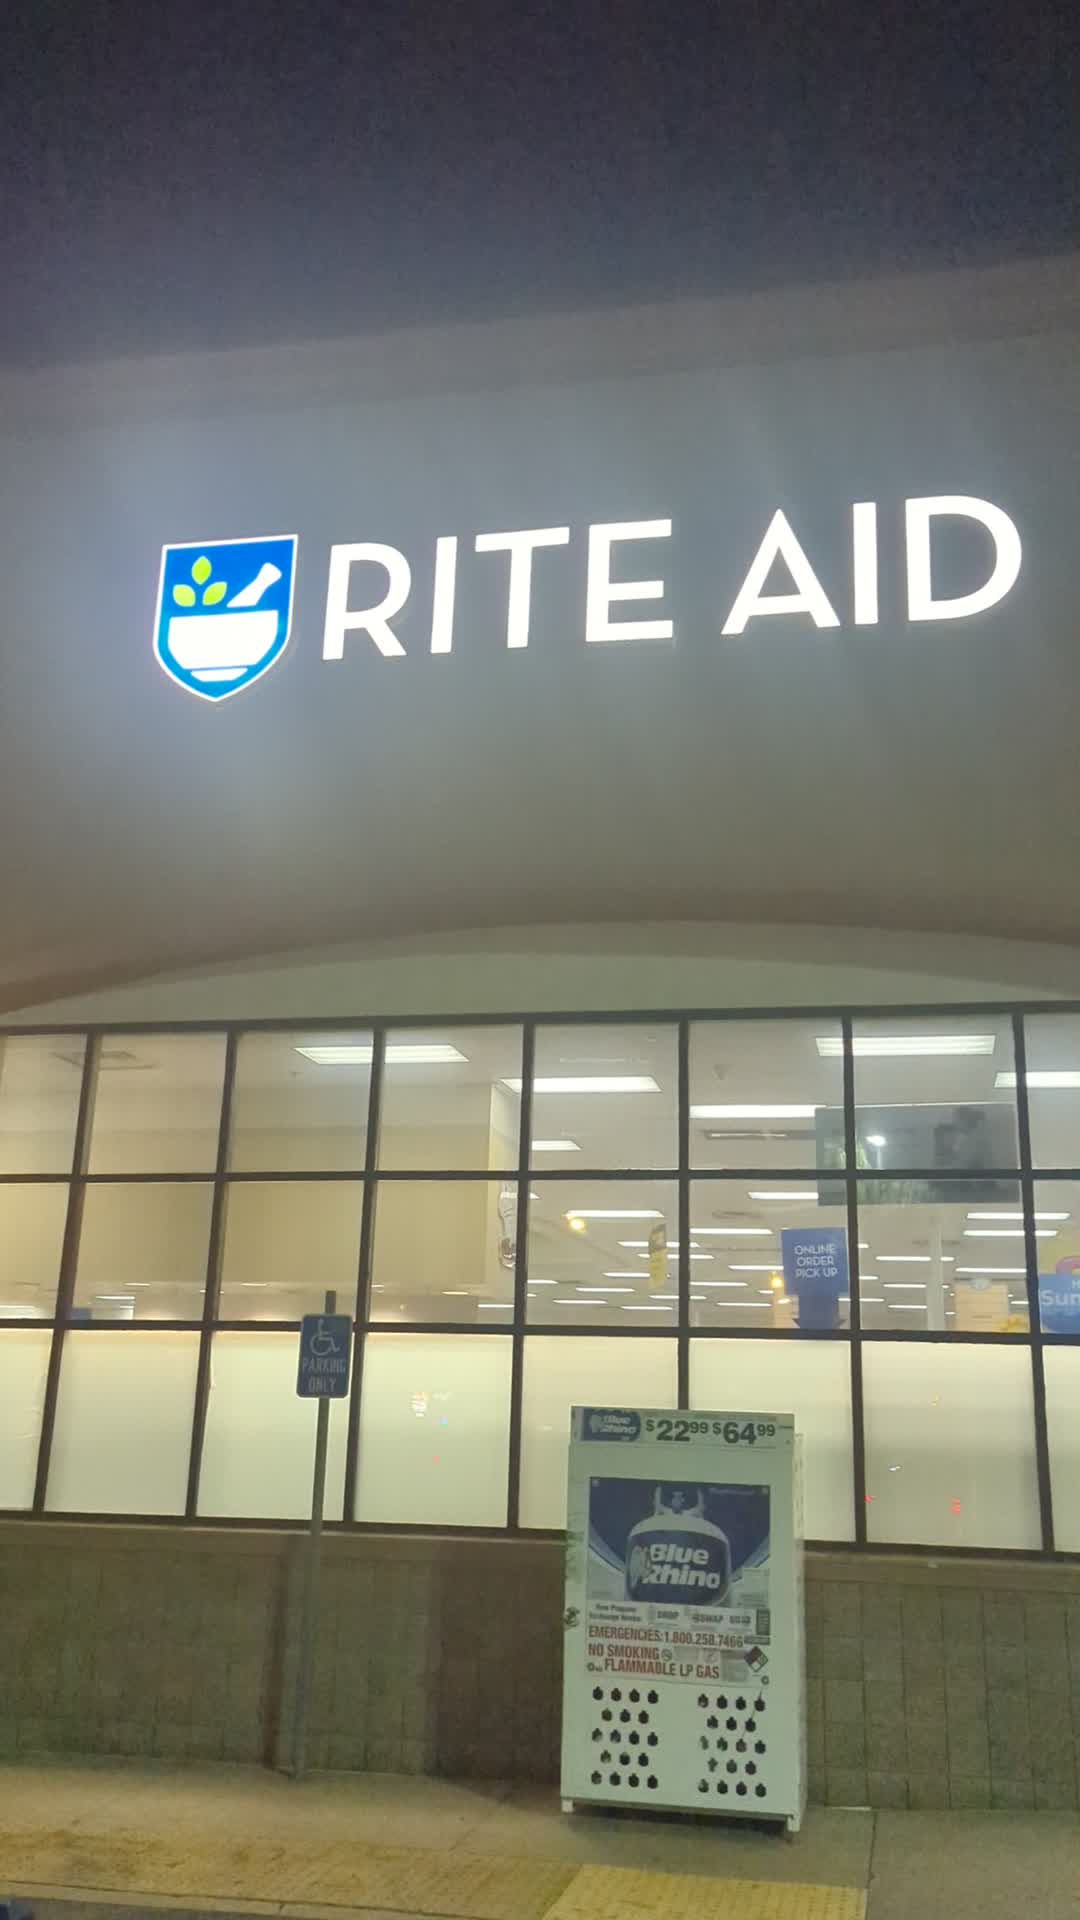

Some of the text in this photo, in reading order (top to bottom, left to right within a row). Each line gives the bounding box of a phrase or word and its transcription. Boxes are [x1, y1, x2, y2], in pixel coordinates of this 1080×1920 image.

[322, 494, 1023, 661] RITE AID
[794, 1243, 837, 1256] ONLINE
[796, 1255, 835, 1267] ORDER
[794, 1267, 839, 1280] PICK UP
[302, 1357, 346, 1376] PARKING
[308, 1376, 338, 1393] ONLY
[649, 1543, 710, 1566] Blue
[588, 1643, 660, 1661] NO SMOKING
[603, 1658, 677, 1677] FLAMMABLE
[679, 1663, 695, 1677] LP
[696, 1664, 720, 1680] GAS
